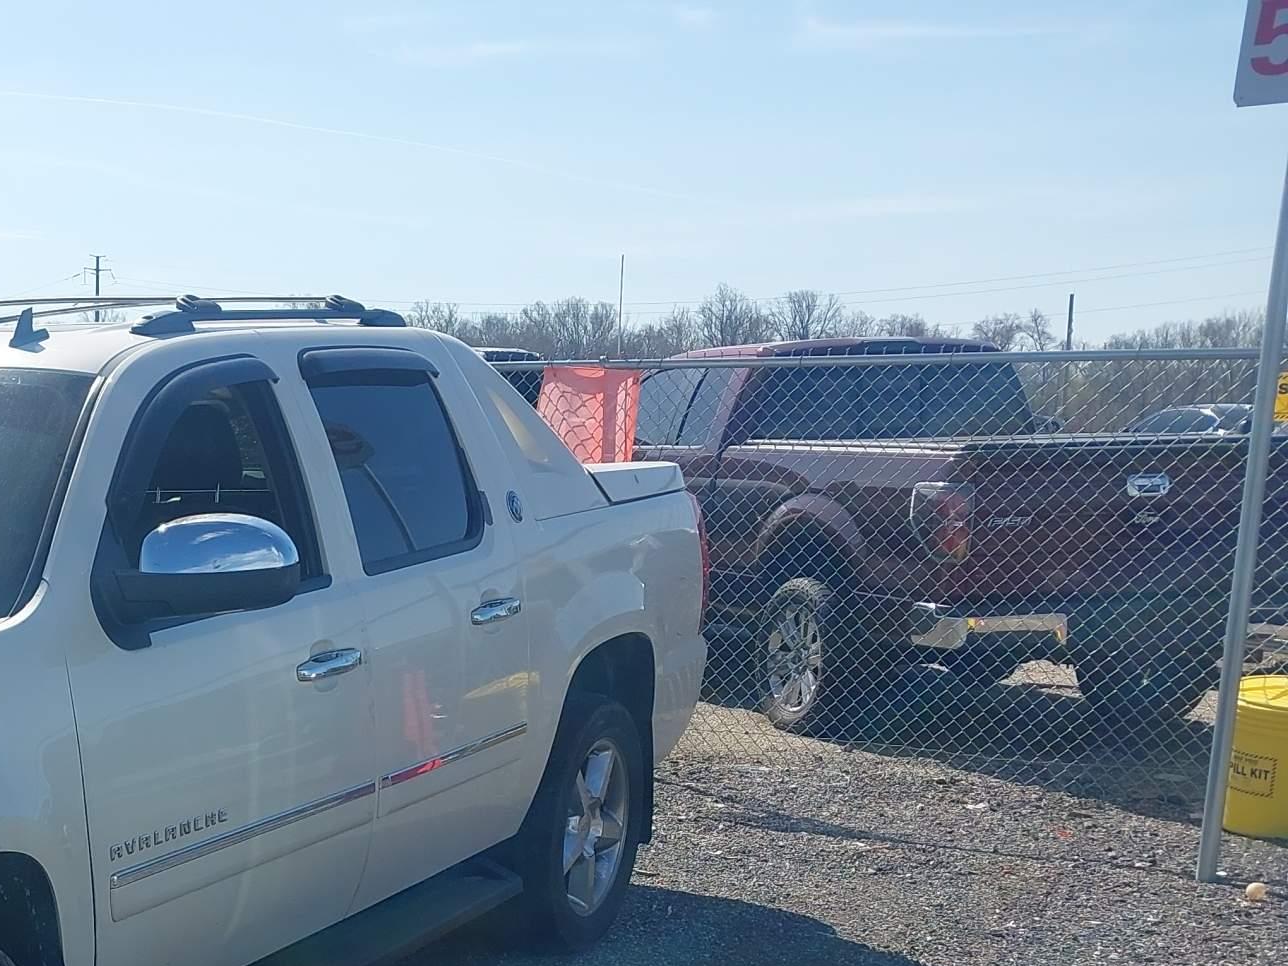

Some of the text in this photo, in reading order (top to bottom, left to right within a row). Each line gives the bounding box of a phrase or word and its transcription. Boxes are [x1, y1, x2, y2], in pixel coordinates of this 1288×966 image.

[1229, 760, 1247, 777] PILL
[1250, 767, 1270, 780] KIT
[109, 807, 229, 862] AVALANCHE
